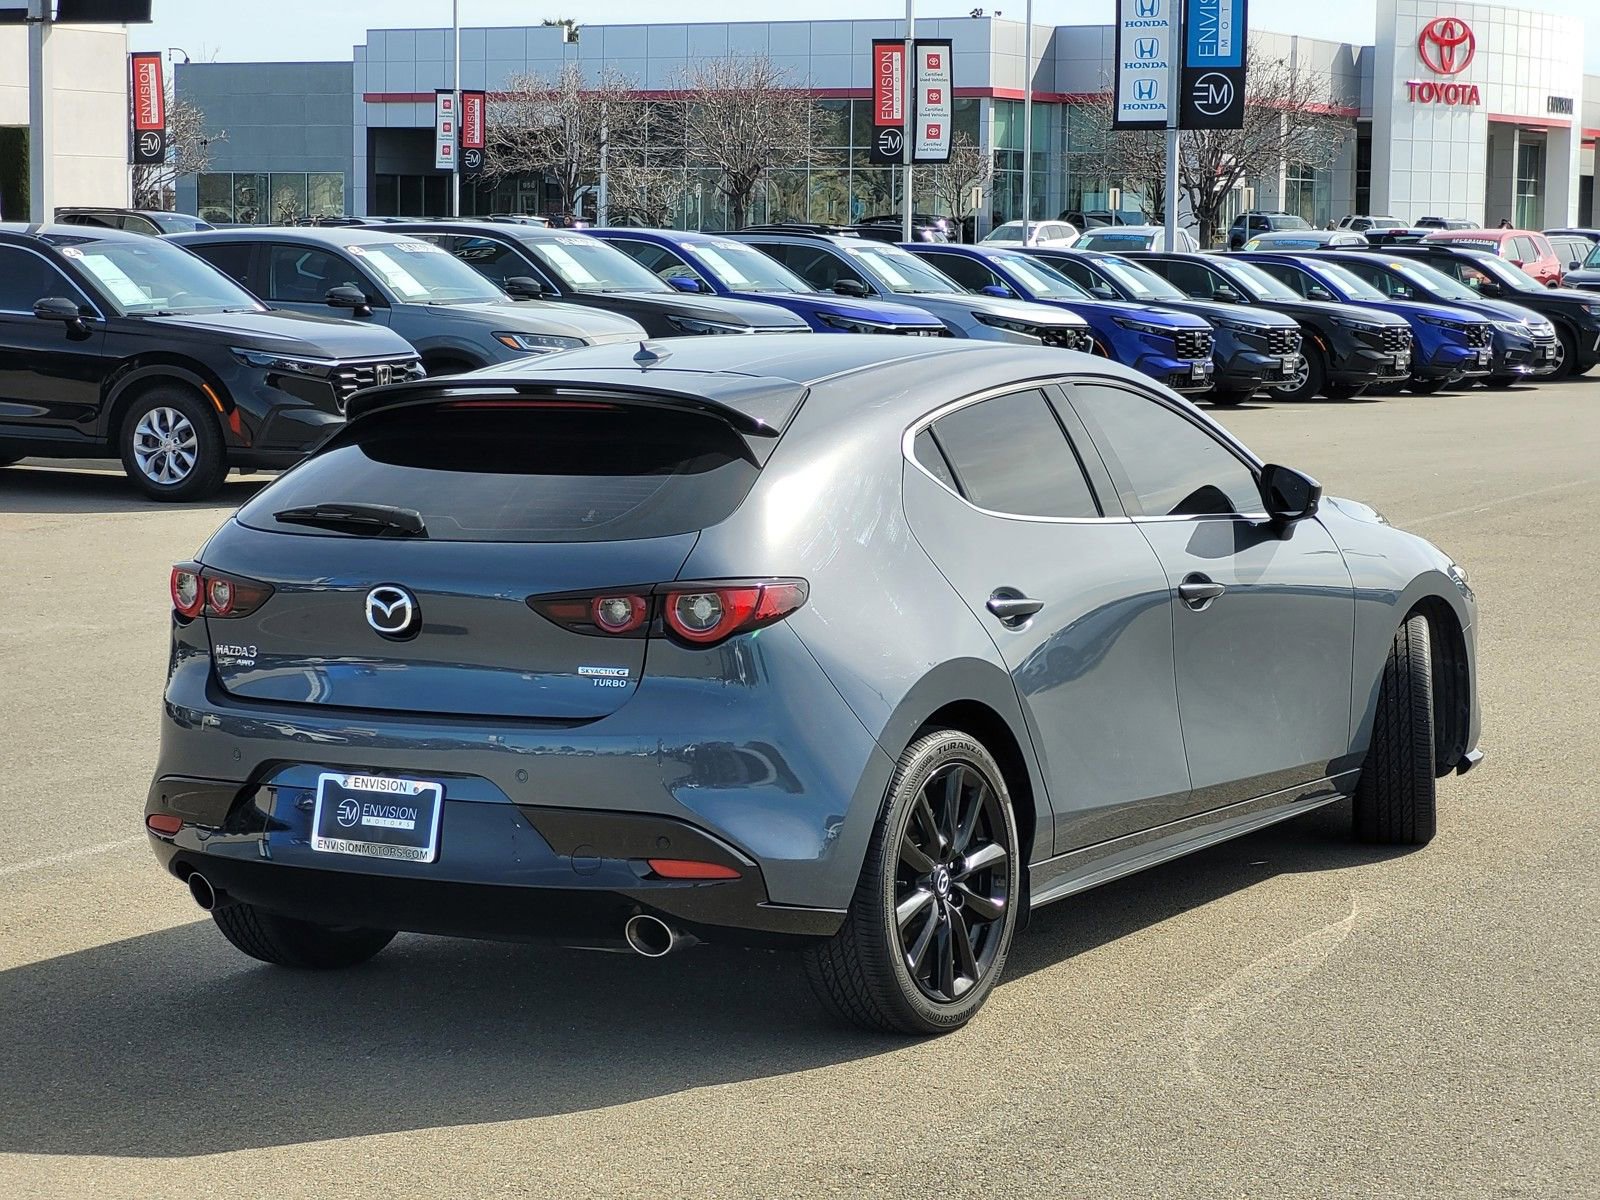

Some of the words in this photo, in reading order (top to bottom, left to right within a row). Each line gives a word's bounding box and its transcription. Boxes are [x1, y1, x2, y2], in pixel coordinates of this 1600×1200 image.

[1124, 20, 1168, 28] HONDA
[139, 63, 151, 124] ENVISION
[881, 51, 893, 120] ENVISION
[1406, 81, 1480, 106] TOYOTA
[467, 99, 475, 143] ENVISION
[593, 679, 626, 687] TURBO
[937, 741, 983, 758] TURANZA
[353, 777, 408, 792] ENVISION
[362, 804, 417, 820] ENVISION
[366, 819, 411, 827] MOTORS
[317, 840, 428, 860] ENVISIONMOTORS.COM
